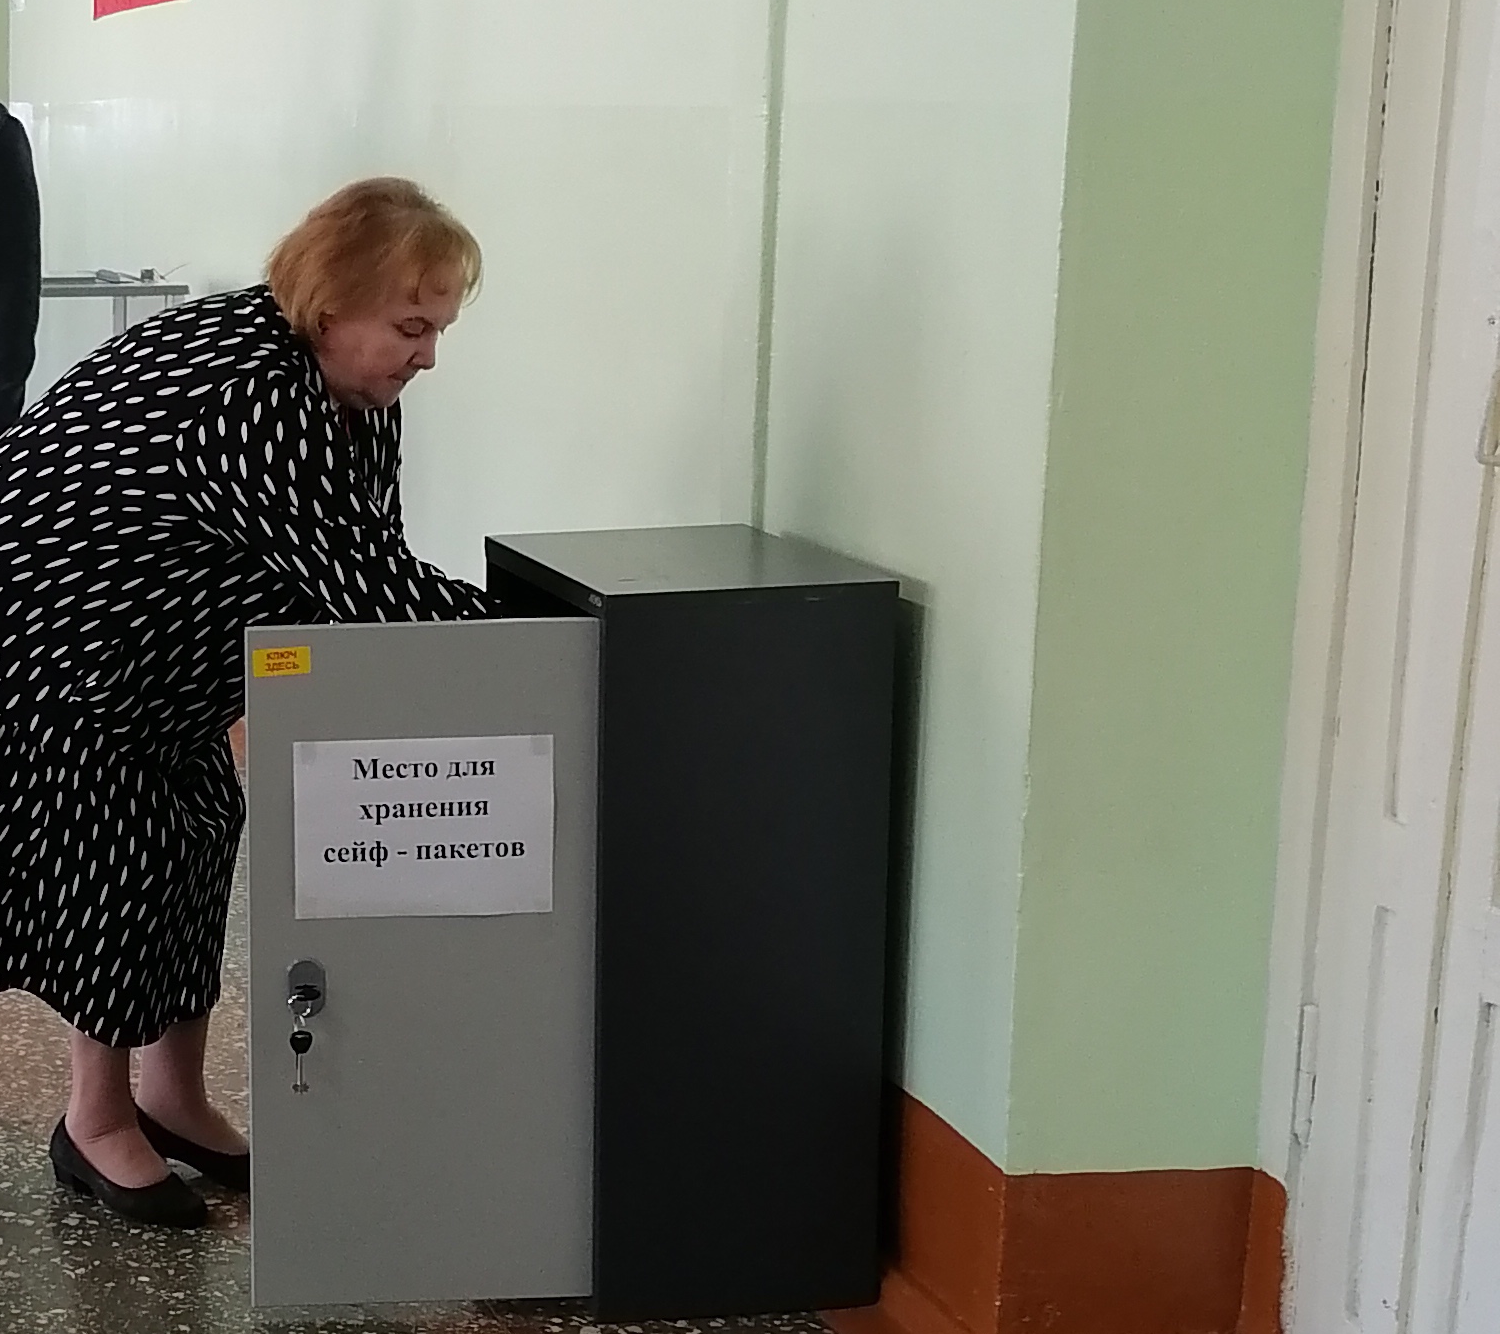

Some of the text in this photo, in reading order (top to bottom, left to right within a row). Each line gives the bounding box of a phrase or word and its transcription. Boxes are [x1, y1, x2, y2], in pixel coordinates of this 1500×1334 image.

[264, 661, 300, 672] ЗДЕСЬ
[266, 650, 297, 661] КЛЮЧ
[352, 757, 496, 781] Место для
[359, 799, 489, 826] хранения
[323, 840, 389, 868] сейф
[415, 840, 526, 861] пакетов
